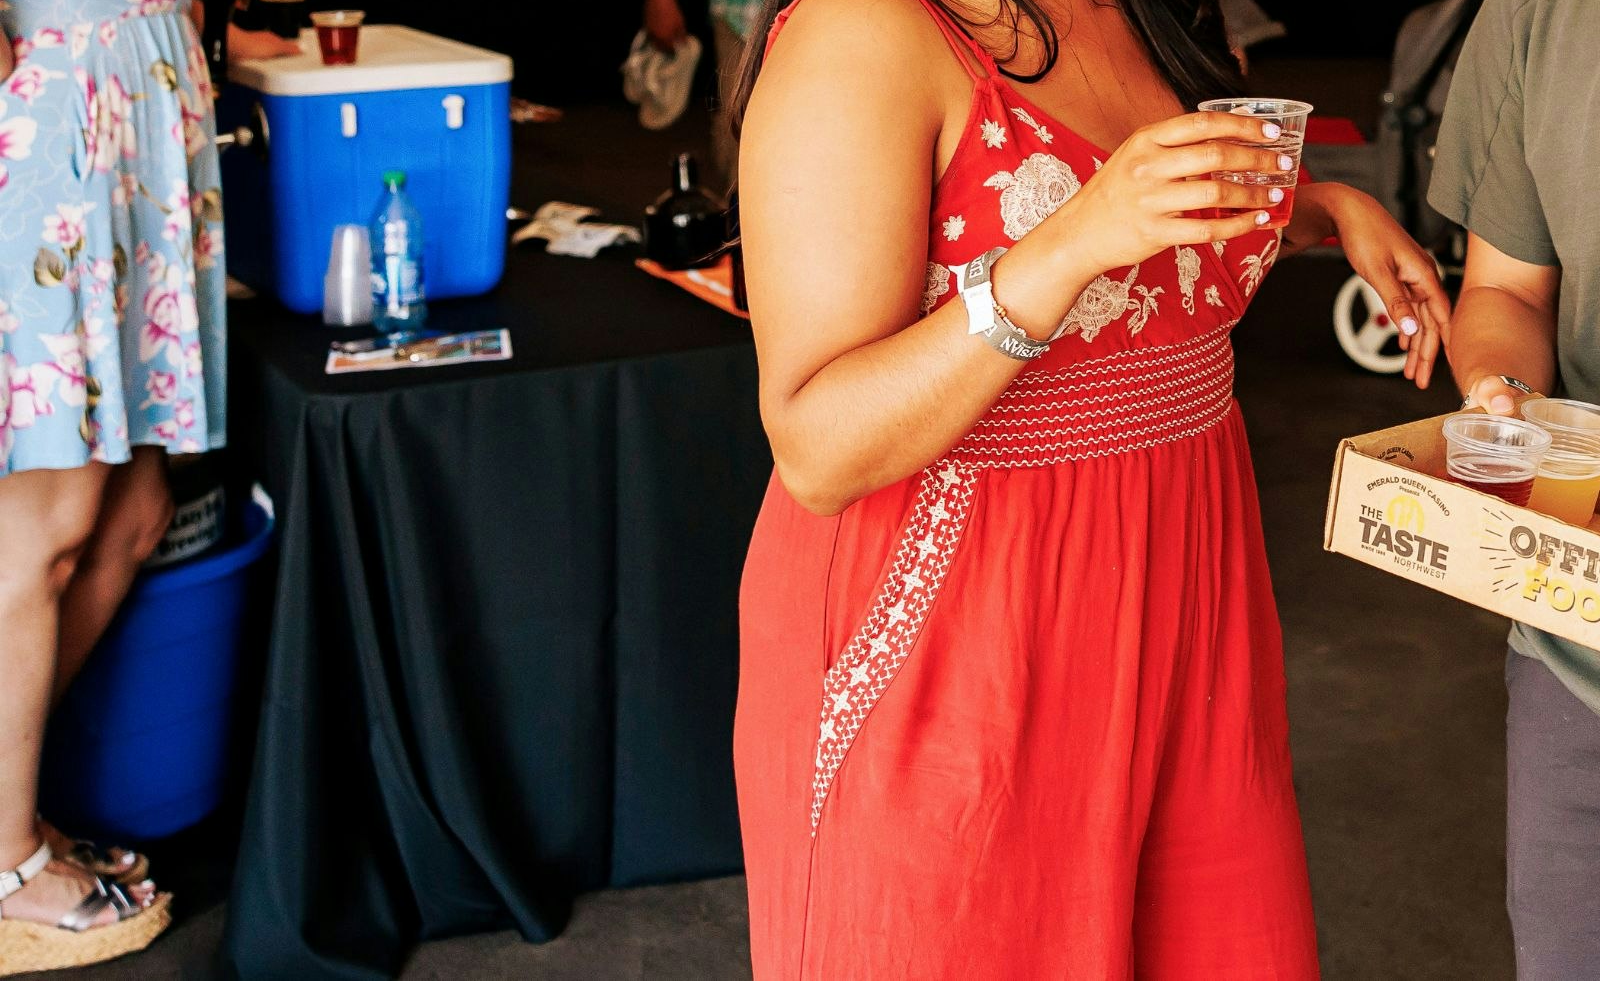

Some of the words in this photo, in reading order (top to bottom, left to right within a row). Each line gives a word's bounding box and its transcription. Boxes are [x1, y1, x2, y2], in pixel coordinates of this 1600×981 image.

[1360, 504, 1384, 521] THE
[1366, 476, 1400, 492] EMERALD
[1401, 477, 1428, 493] QUEEN
[1427, 489, 1451, 517] CASINO
[1358, 515, 1450, 571] TASTE
[1393, 555, 1447, 581] NORTHWEST
